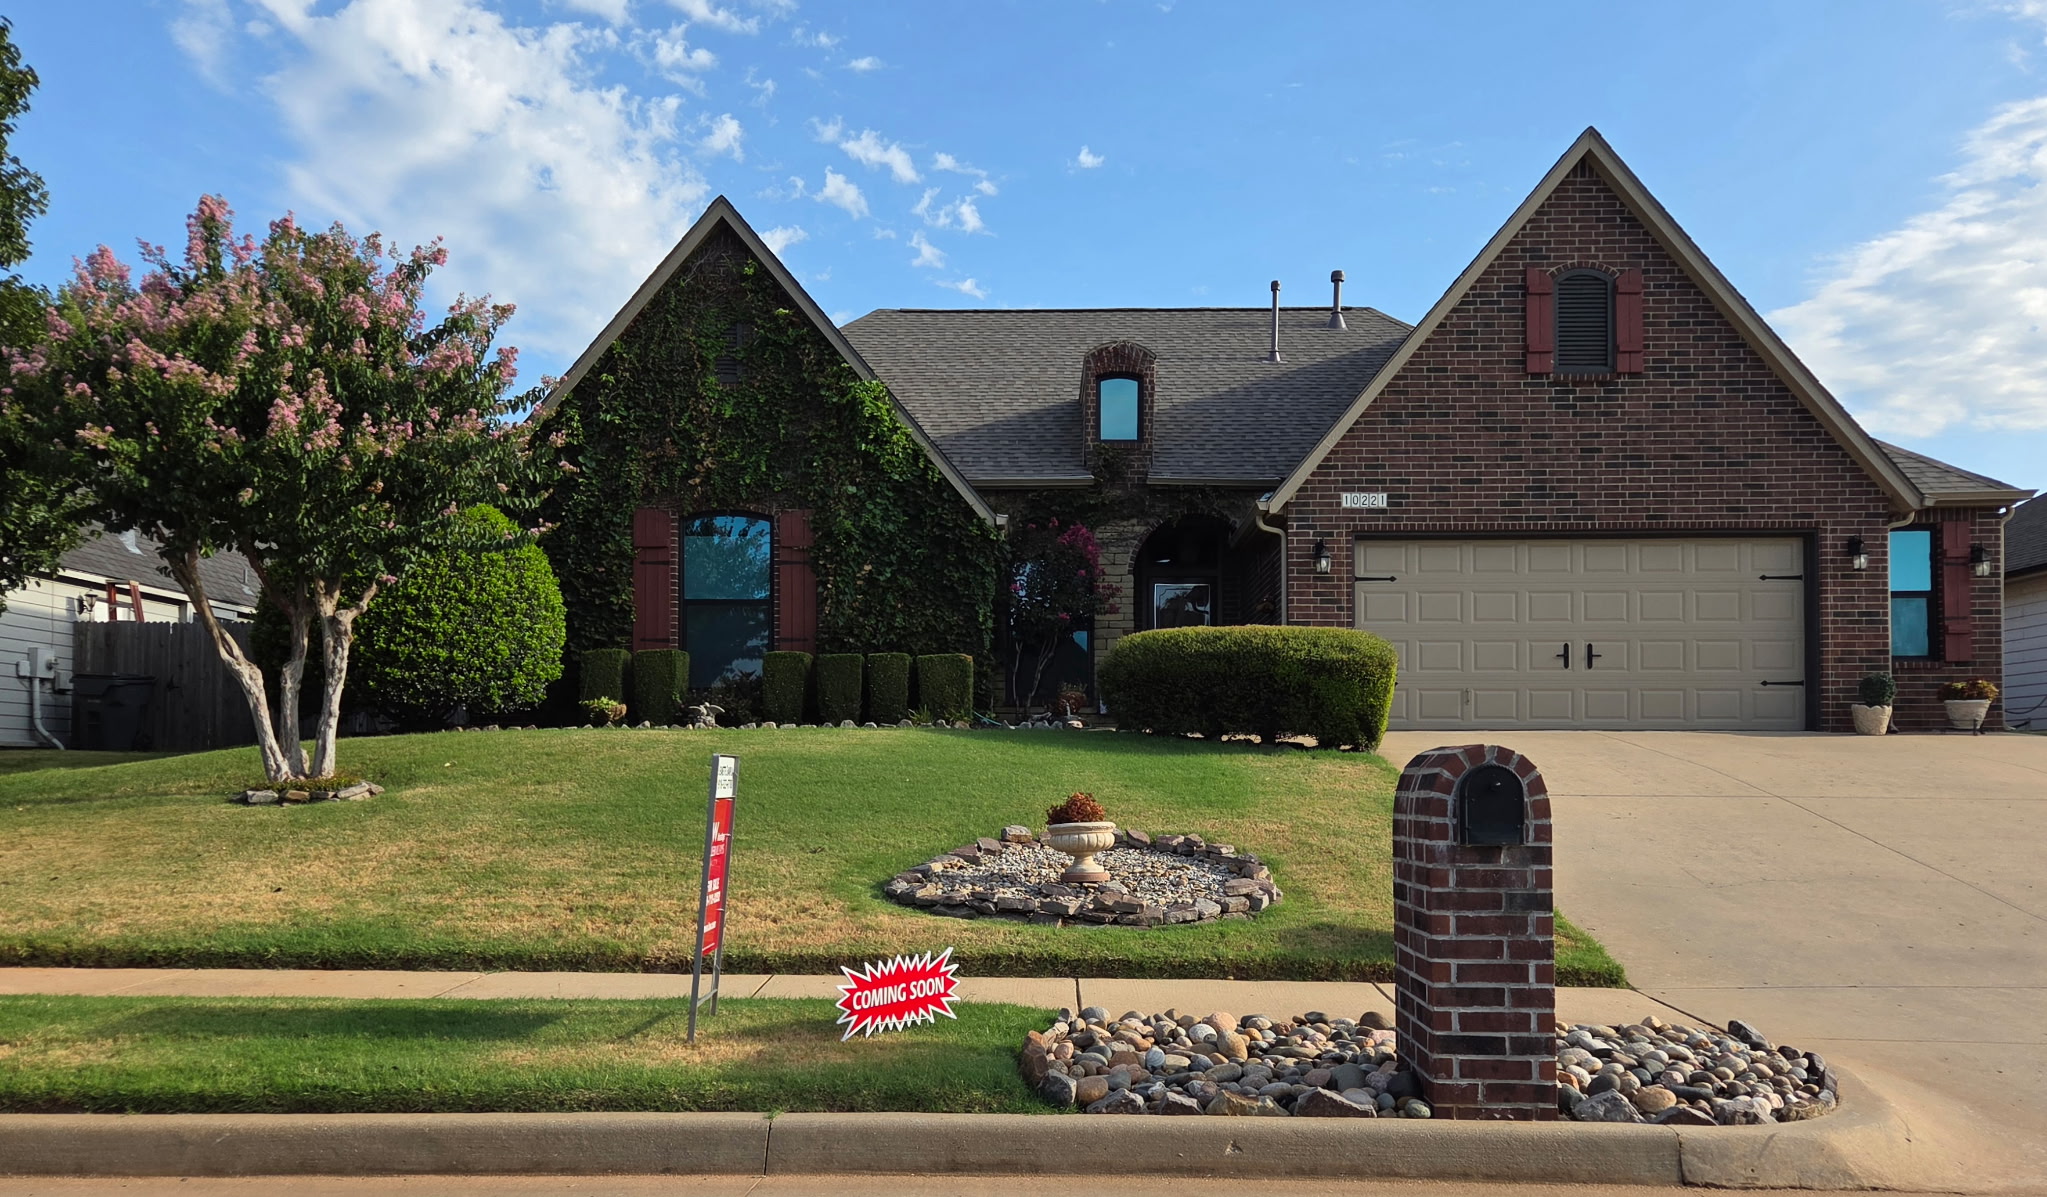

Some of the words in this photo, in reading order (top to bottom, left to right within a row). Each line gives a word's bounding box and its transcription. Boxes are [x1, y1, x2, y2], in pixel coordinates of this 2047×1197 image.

[1344, 494, 1385, 506] 10221
[852, 982, 907, 1010] COMING
[909, 976, 945, 1000] SOON
